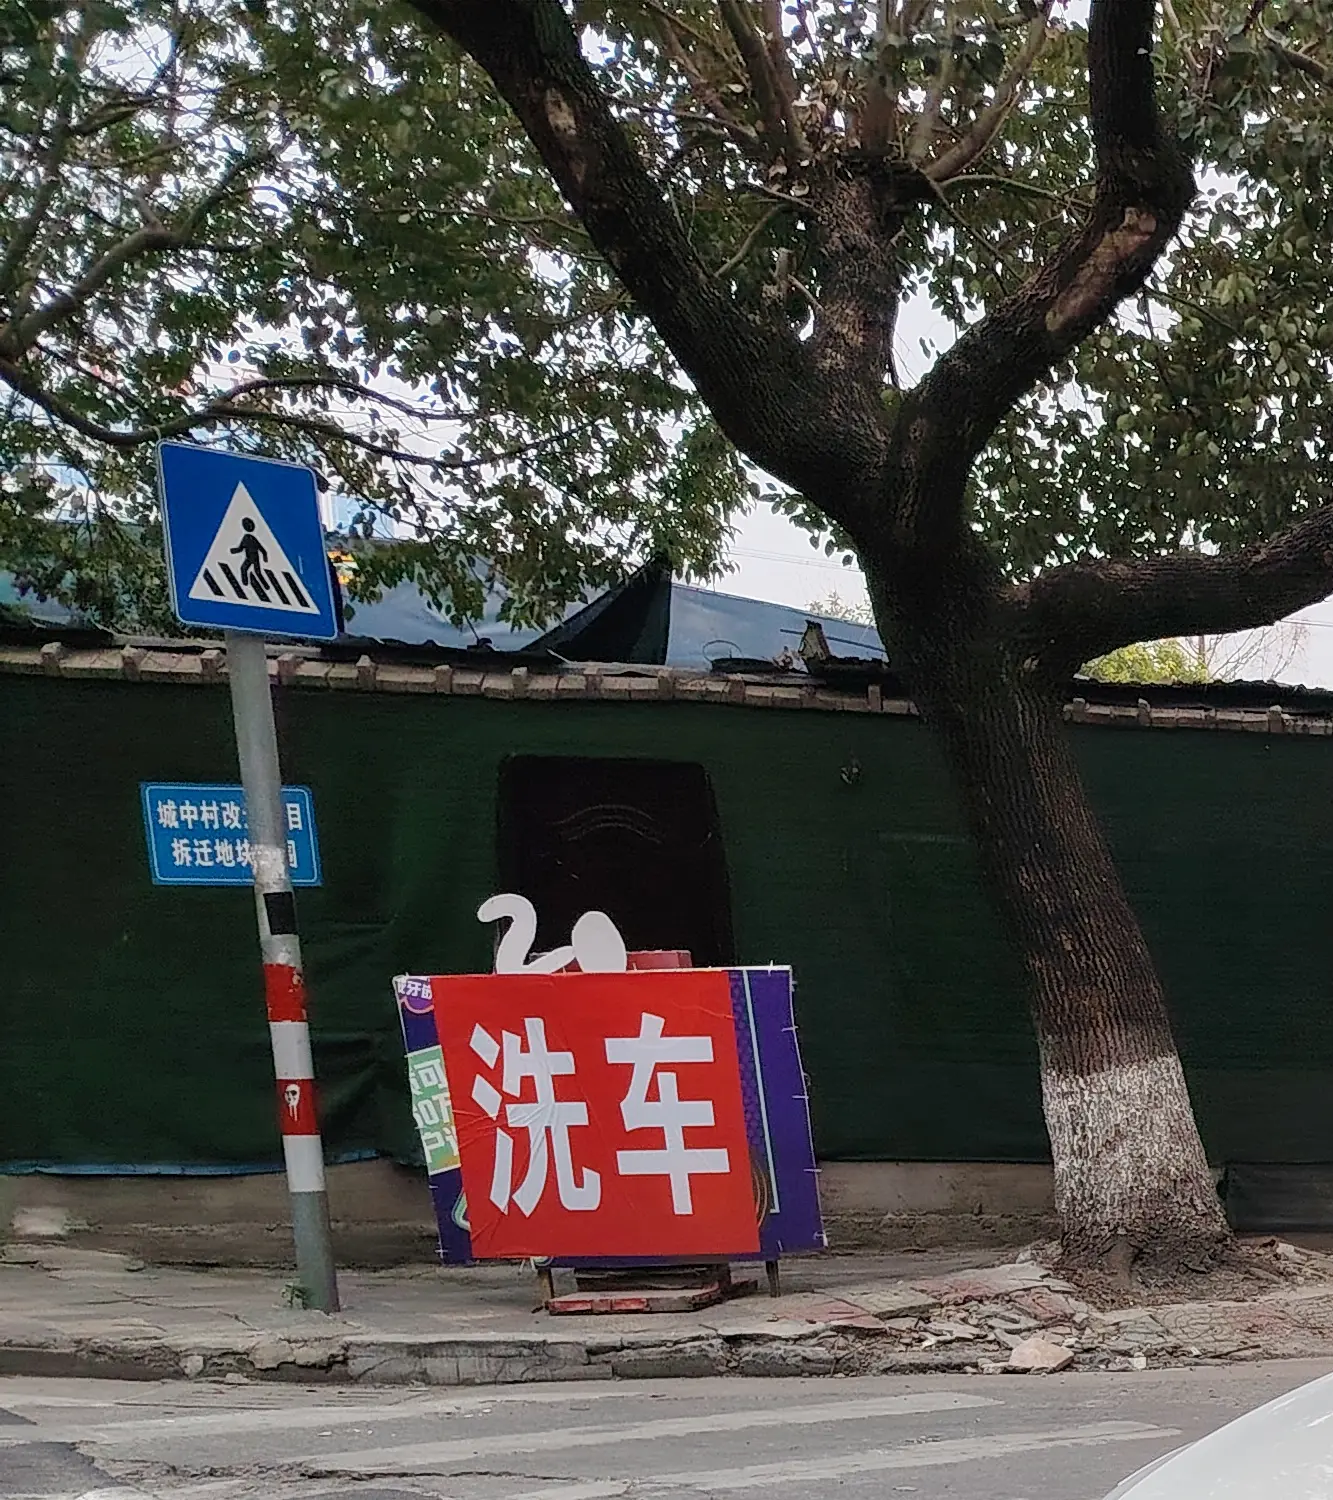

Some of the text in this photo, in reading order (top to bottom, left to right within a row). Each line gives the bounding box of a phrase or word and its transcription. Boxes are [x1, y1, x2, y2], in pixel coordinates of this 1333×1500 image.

[157, 799, 303, 831] 城中村改目
[171, 837, 299, 869] 拆迁地块
[469, 1012, 731, 1218] 洗车
